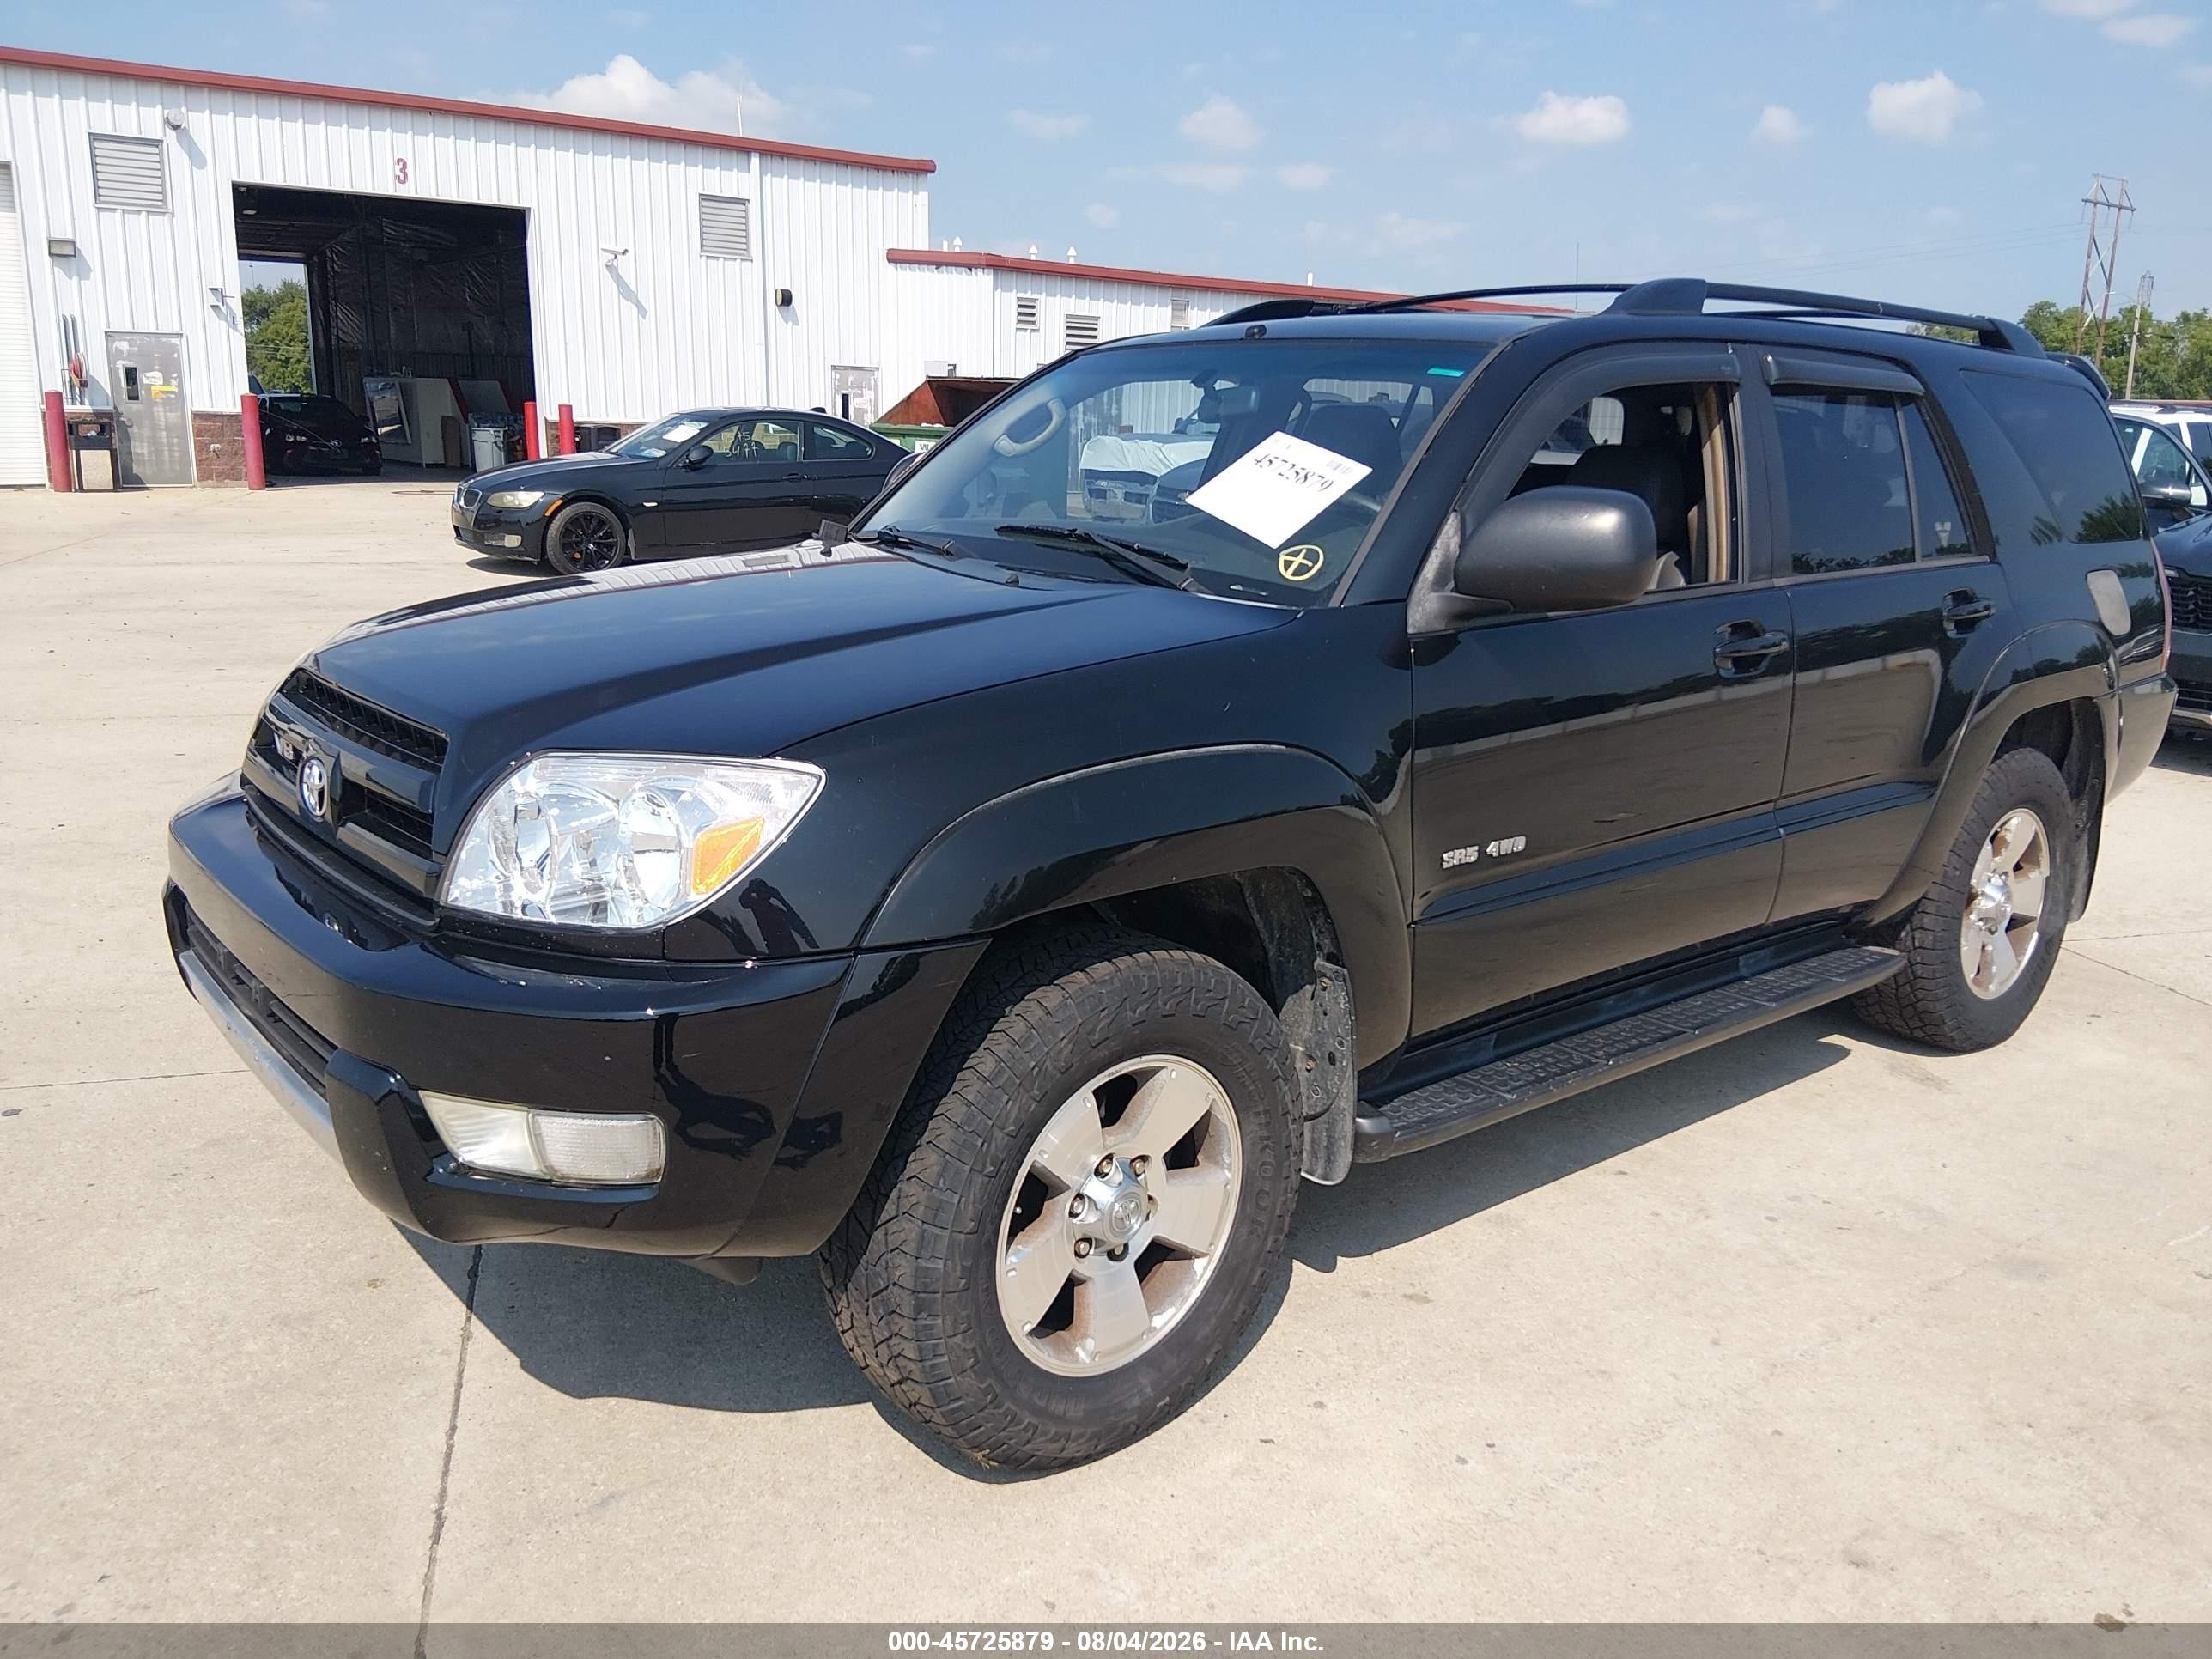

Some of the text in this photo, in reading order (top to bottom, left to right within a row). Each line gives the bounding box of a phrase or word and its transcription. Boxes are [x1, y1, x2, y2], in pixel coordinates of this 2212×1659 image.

[396, 157, 409, 185] 3
[1253, 453, 1334, 493] 45725879
[1442, 836, 1527, 869] SR5 4WD
